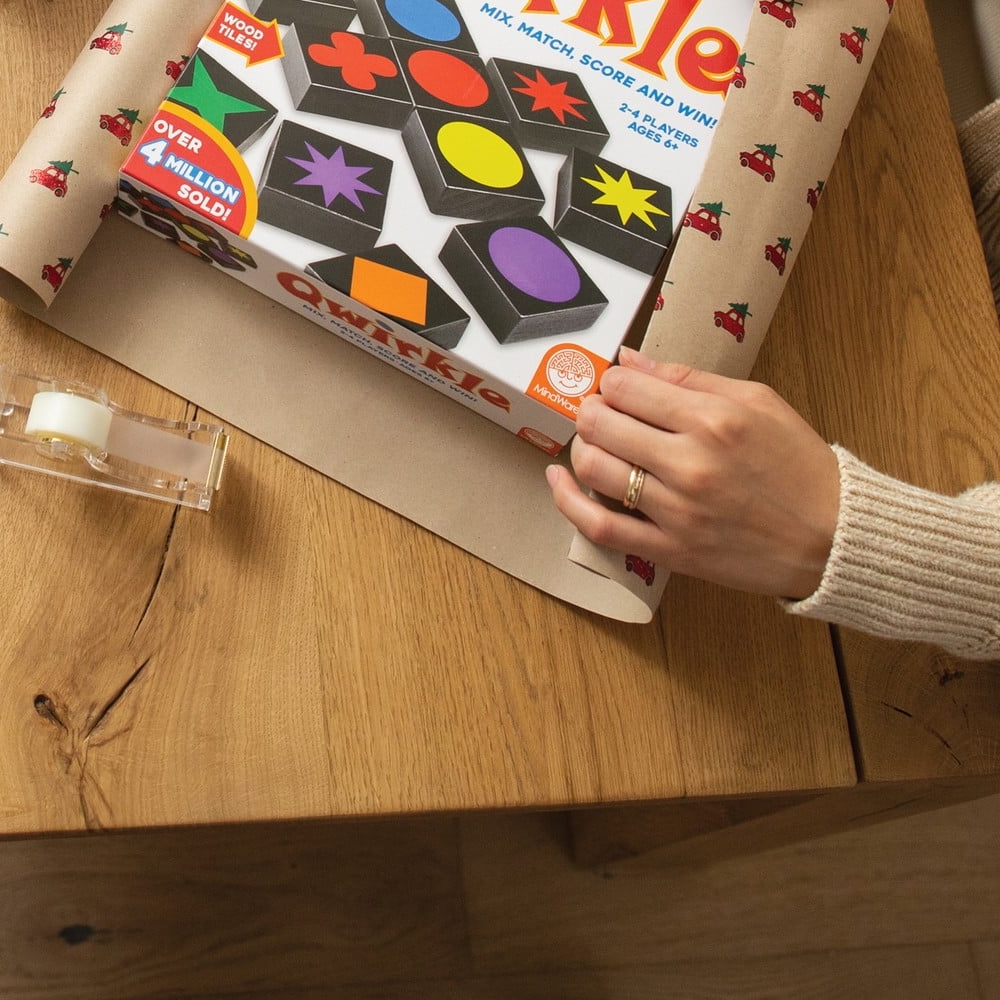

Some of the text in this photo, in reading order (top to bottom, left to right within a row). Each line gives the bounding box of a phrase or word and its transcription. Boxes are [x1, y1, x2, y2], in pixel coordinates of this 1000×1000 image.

[218, 23, 258, 52] TILES!
[223, 12, 264, 41] WOOD
[480, 2, 718, 129] MIX, MATCH, SCORE AND WIN!
[153, 119, 203, 154] OVER
[619, 103, 699, 148] 2-4 PLAYERS
[627, 121, 679, 151] AGES 6+
[139, 139, 240, 203] 4 MILLION
[177, 183, 232, 222] SOLD!
[276, 271, 511, 414] Qwirkle
[376, 339, 416, 368] SCORE
[414, 368, 446, 385] AND
[449, 385, 478, 402] WIN!
[533, 384, 579, 414] MindWare
